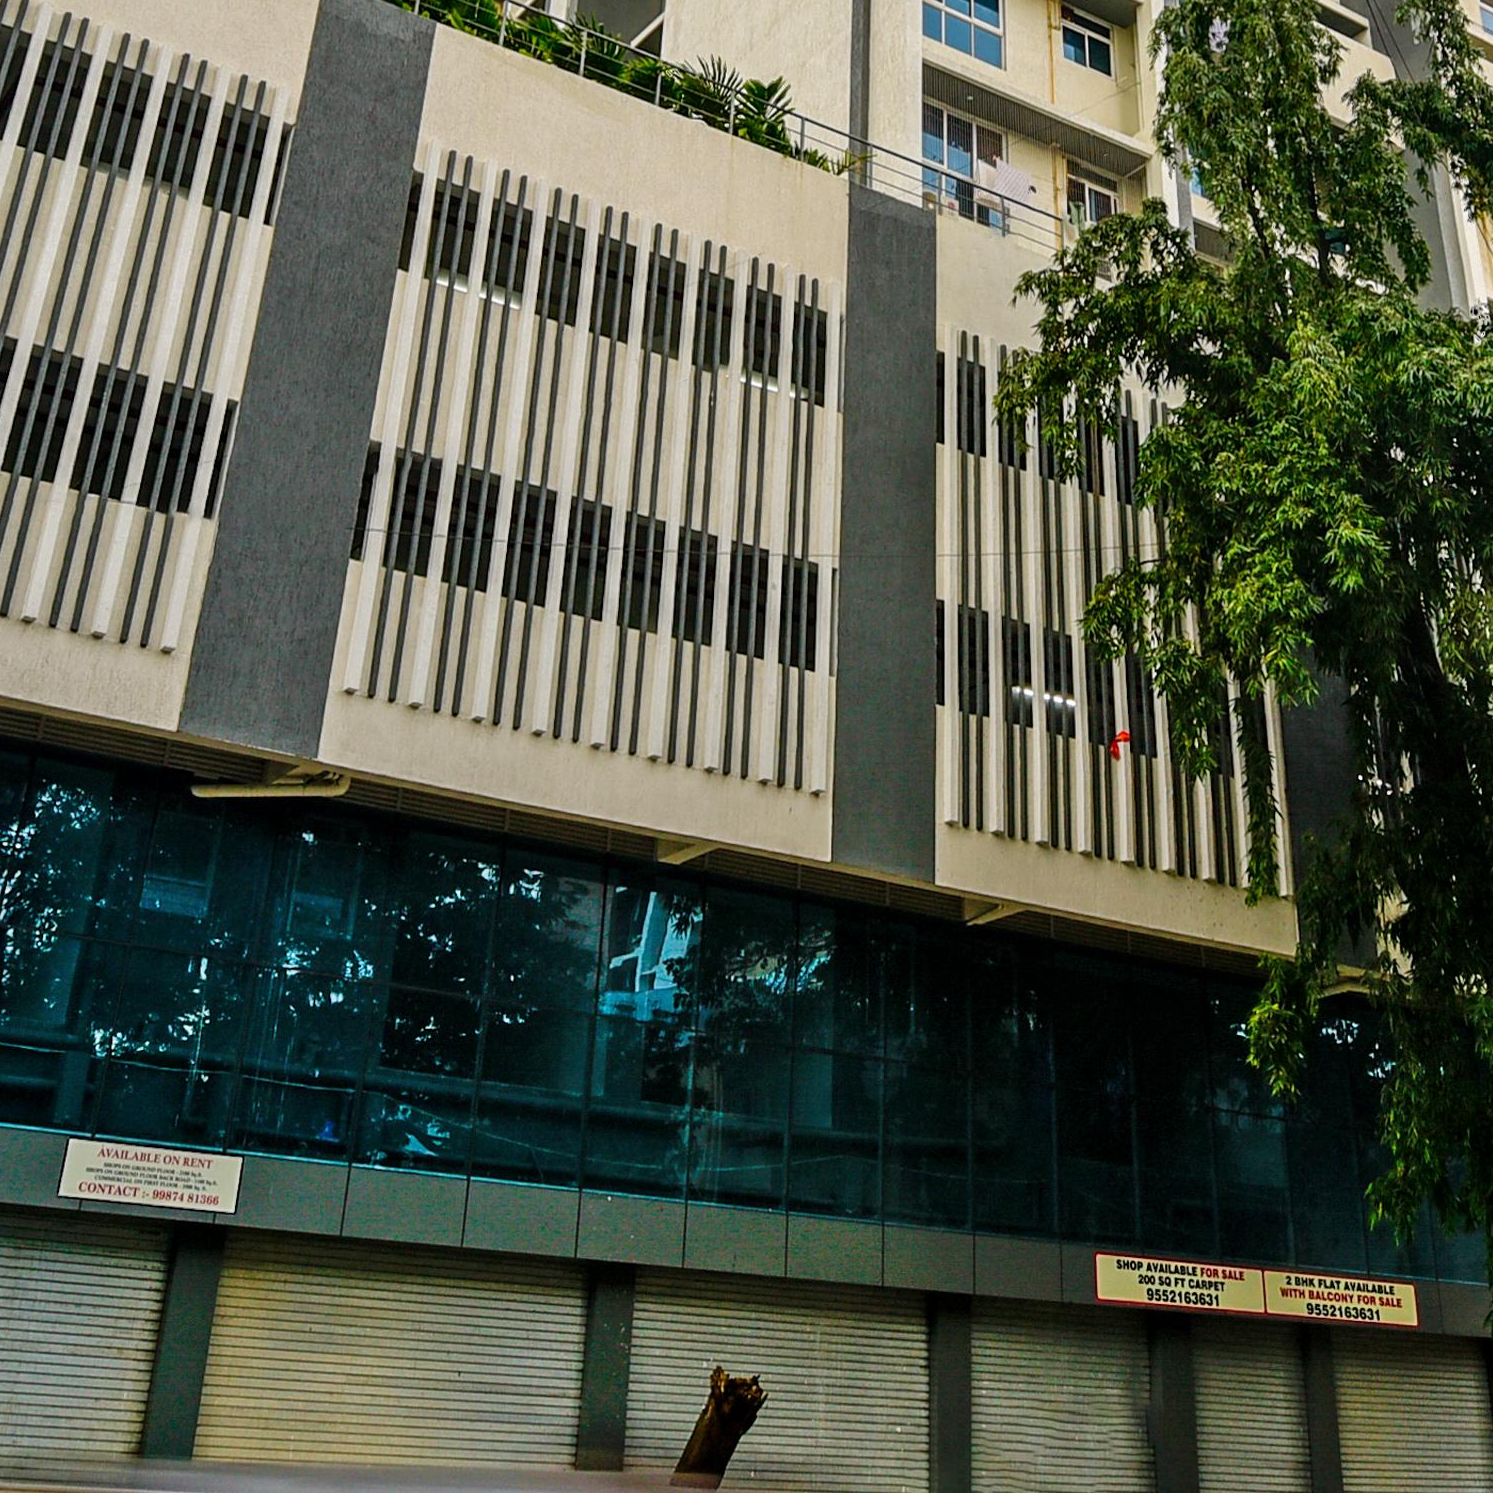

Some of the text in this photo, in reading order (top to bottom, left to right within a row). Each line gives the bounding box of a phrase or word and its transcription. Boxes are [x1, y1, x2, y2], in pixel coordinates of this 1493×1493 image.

[97, 1147, 214, 1169] AVAILABLE ON RENT
[78, 1181, 140, 1197] CONTACT
[152, 1189, 185, 1202] 99874
[187, 1193, 220, 1206] 81366
[1116, 1259, 1245, 1281] SHOP AVAILABLE FOR SALE
[1138, 1274, 1226, 1292] 200 SQ FT CARPET
[1285, 1275, 1396, 1295] 2 BHK FLAT AVAILABLE
[1146, 1288, 1220, 1307] 9552163631
[1280, 1287, 1403, 1308] WITH BALCONY FOR SALE
[1306, 1303, 1381, 1321] 9552163631
